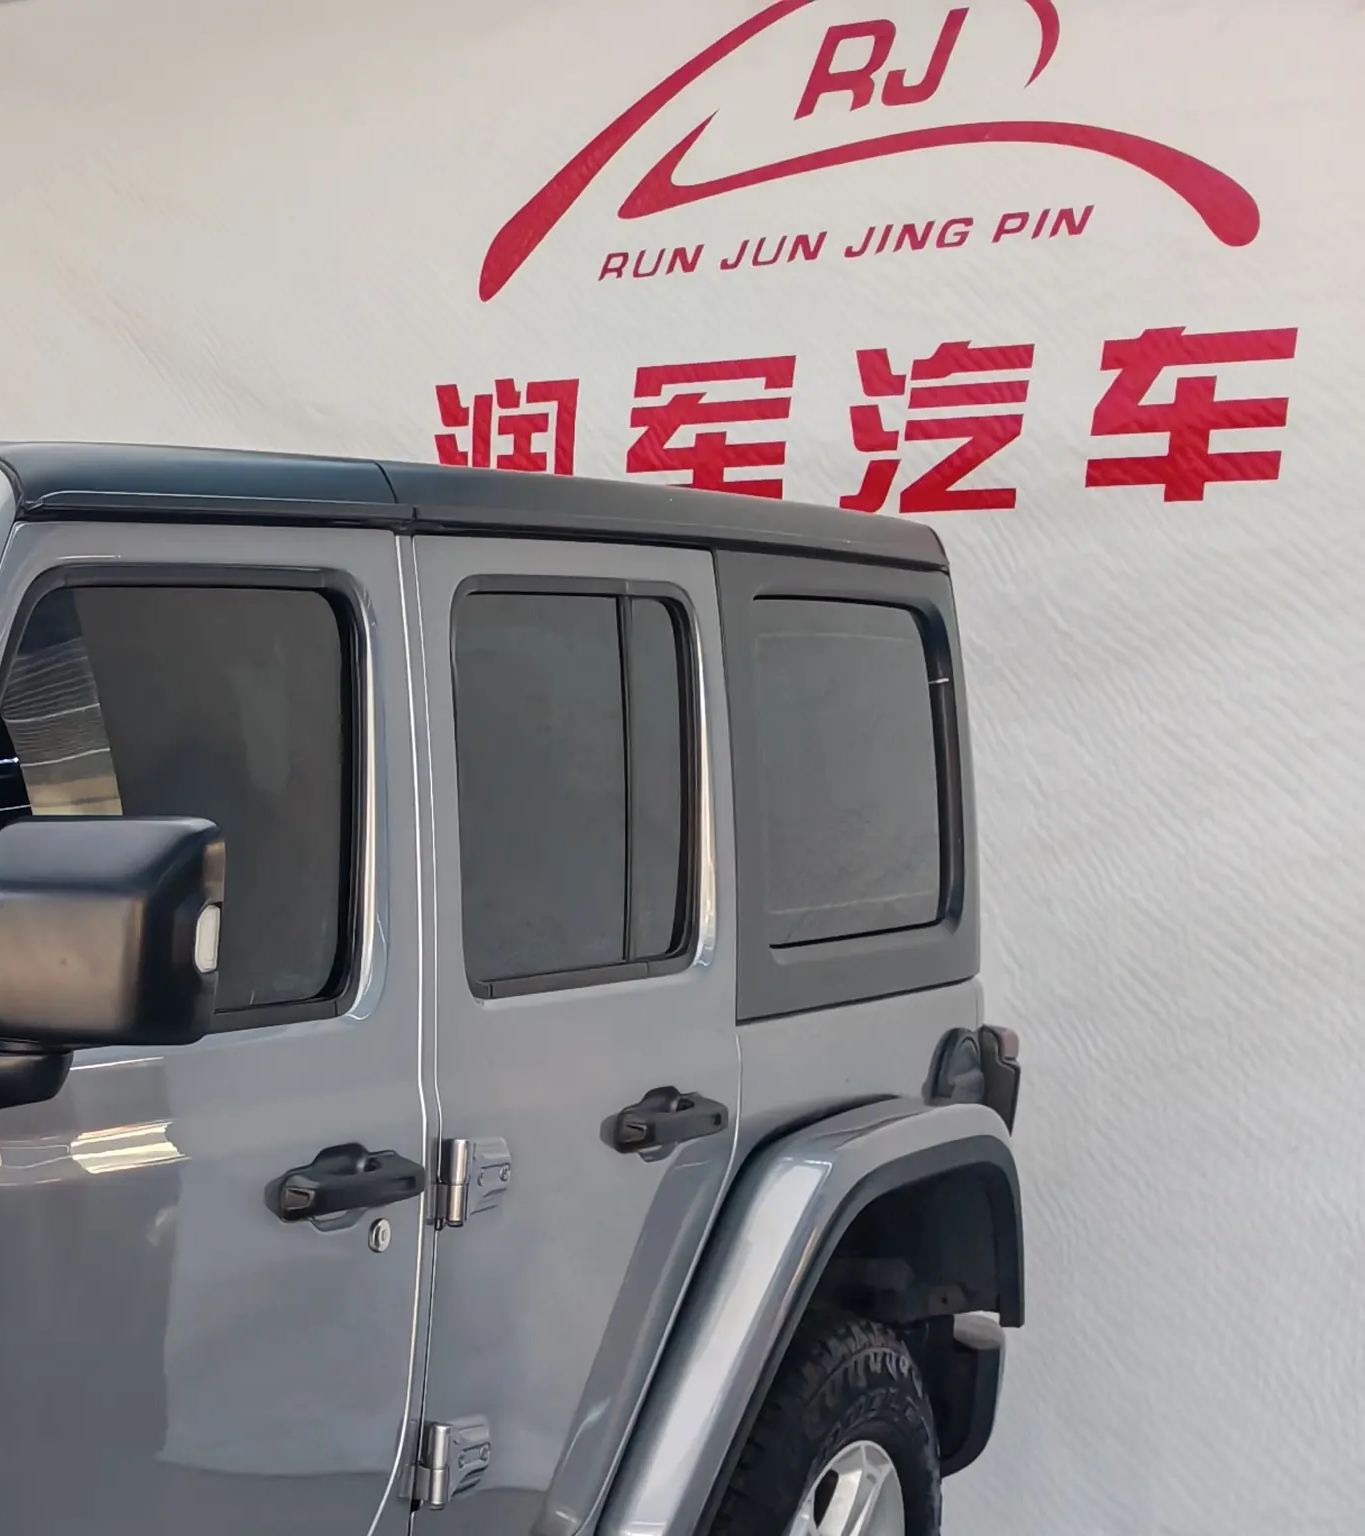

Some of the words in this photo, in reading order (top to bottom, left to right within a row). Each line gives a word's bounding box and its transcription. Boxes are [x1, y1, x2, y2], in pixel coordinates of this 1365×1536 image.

[794, 7, 970, 121] RJ
[598, 244, 705, 281] RUN
[718, 231, 828, 271] JUN
[843, 216, 974, 259] JING
[990, 204, 1096, 244] PIN
[434, 326, 1299, 514] 润军汽车
